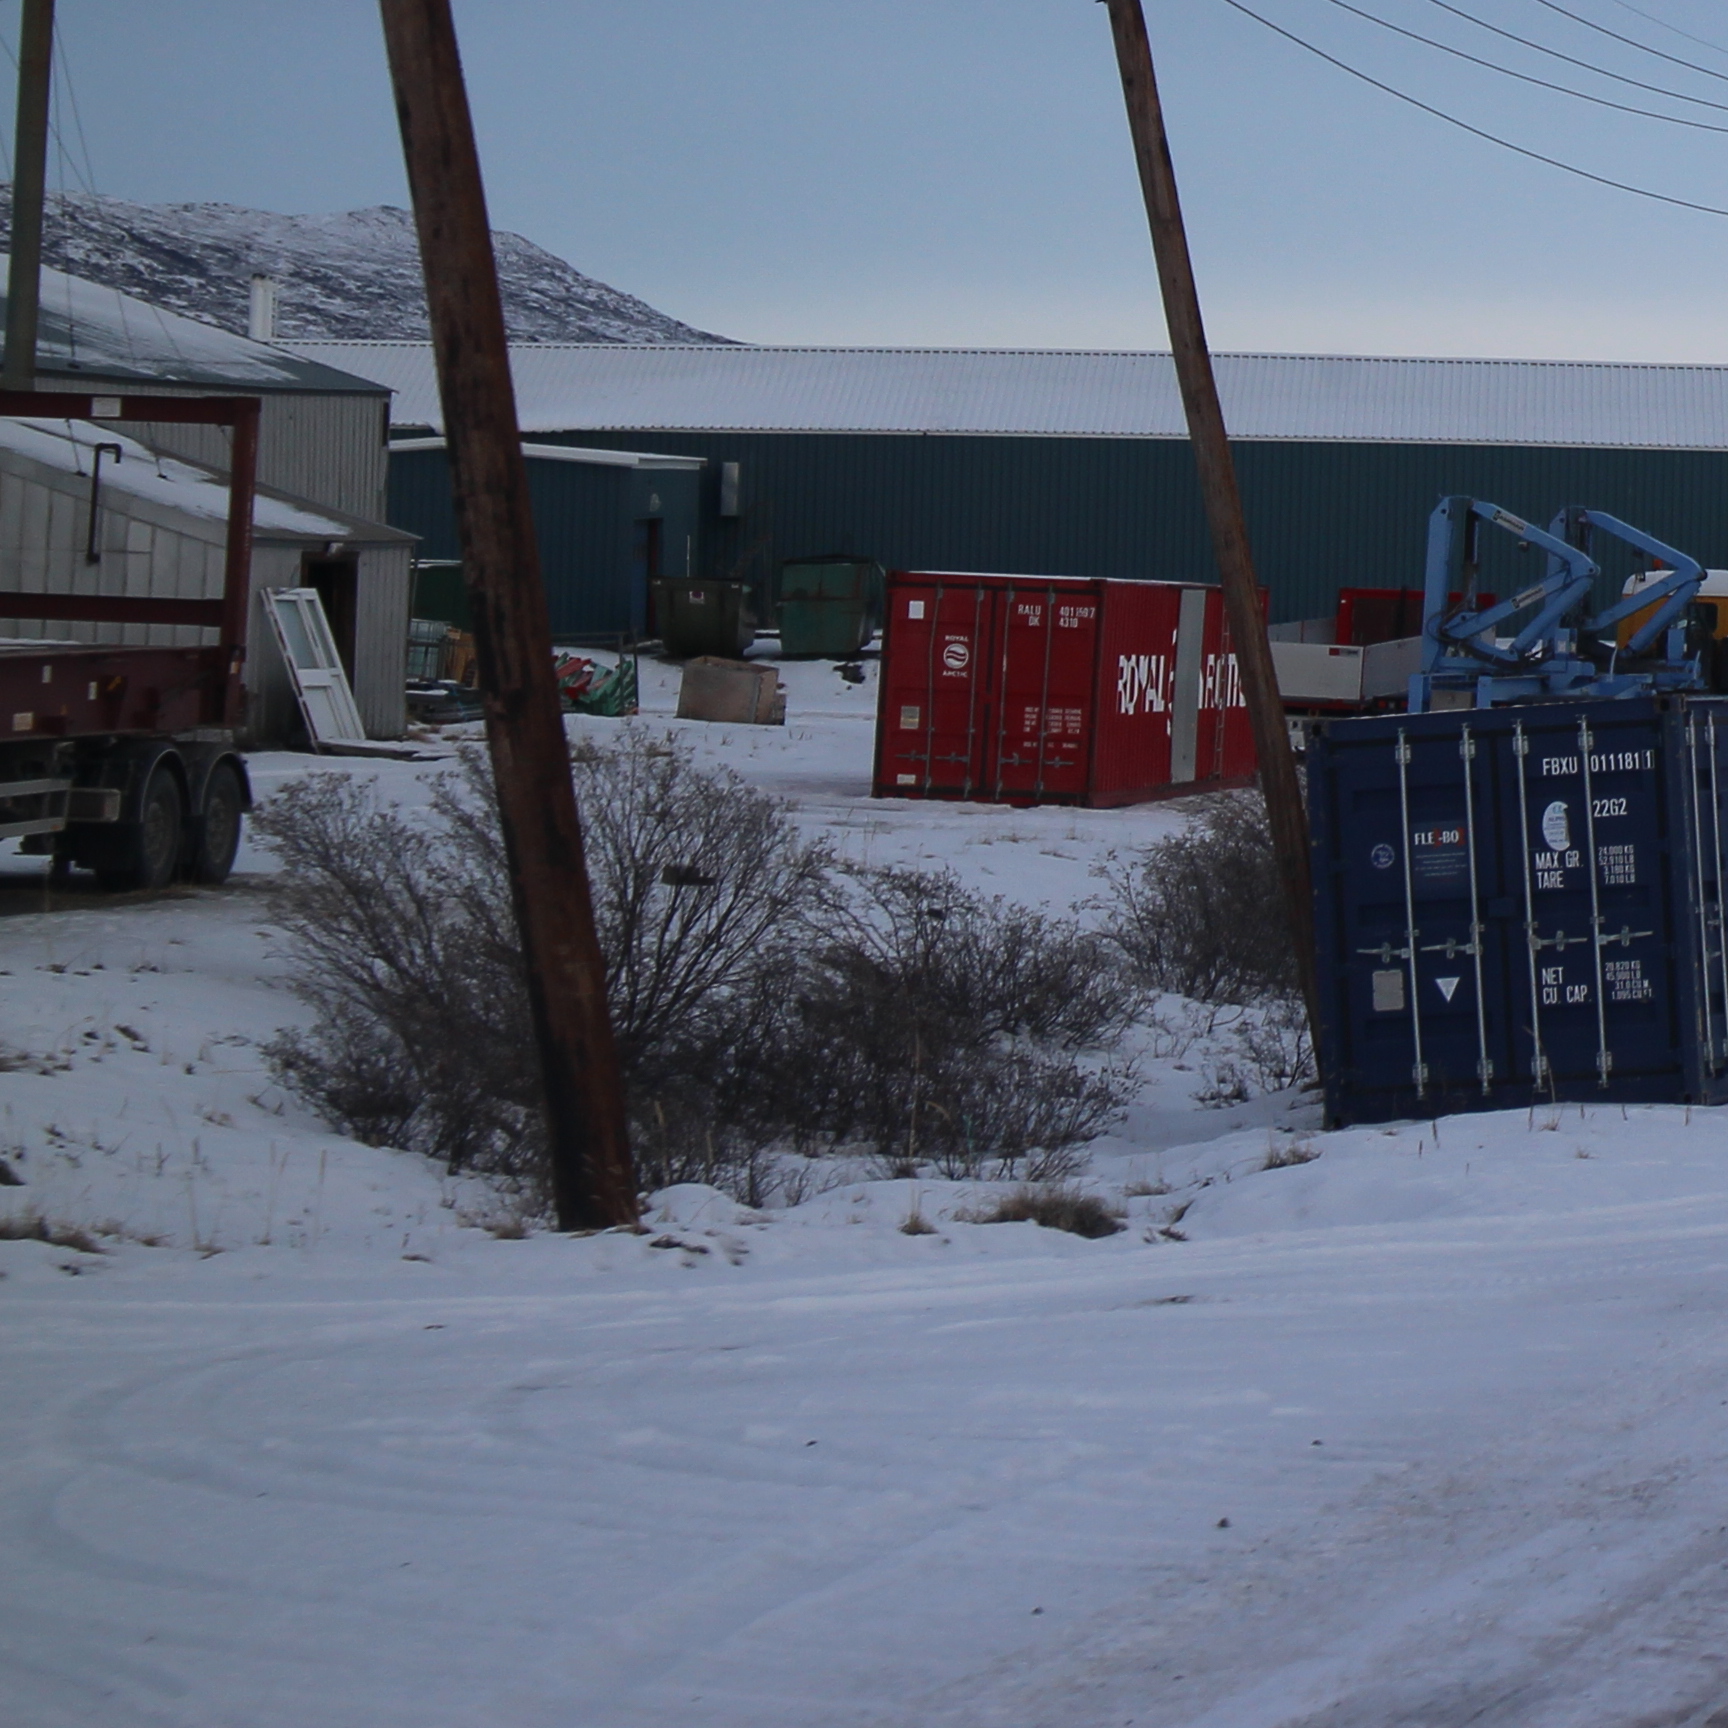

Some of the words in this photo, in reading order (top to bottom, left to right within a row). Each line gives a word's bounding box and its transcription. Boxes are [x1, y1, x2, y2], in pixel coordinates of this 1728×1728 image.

[1018, 604, 1041, 616] RALU
[1116, 655, 1165, 715] ROYAL
[1542, 756, 1578, 776] FBXU
[1592, 798, 1628, 818] 22G2
[1537, 870, 1564, 889] TARE
[1541, 966, 1564, 985] NET
[1566, 984, 1592, 1003] CAP.
